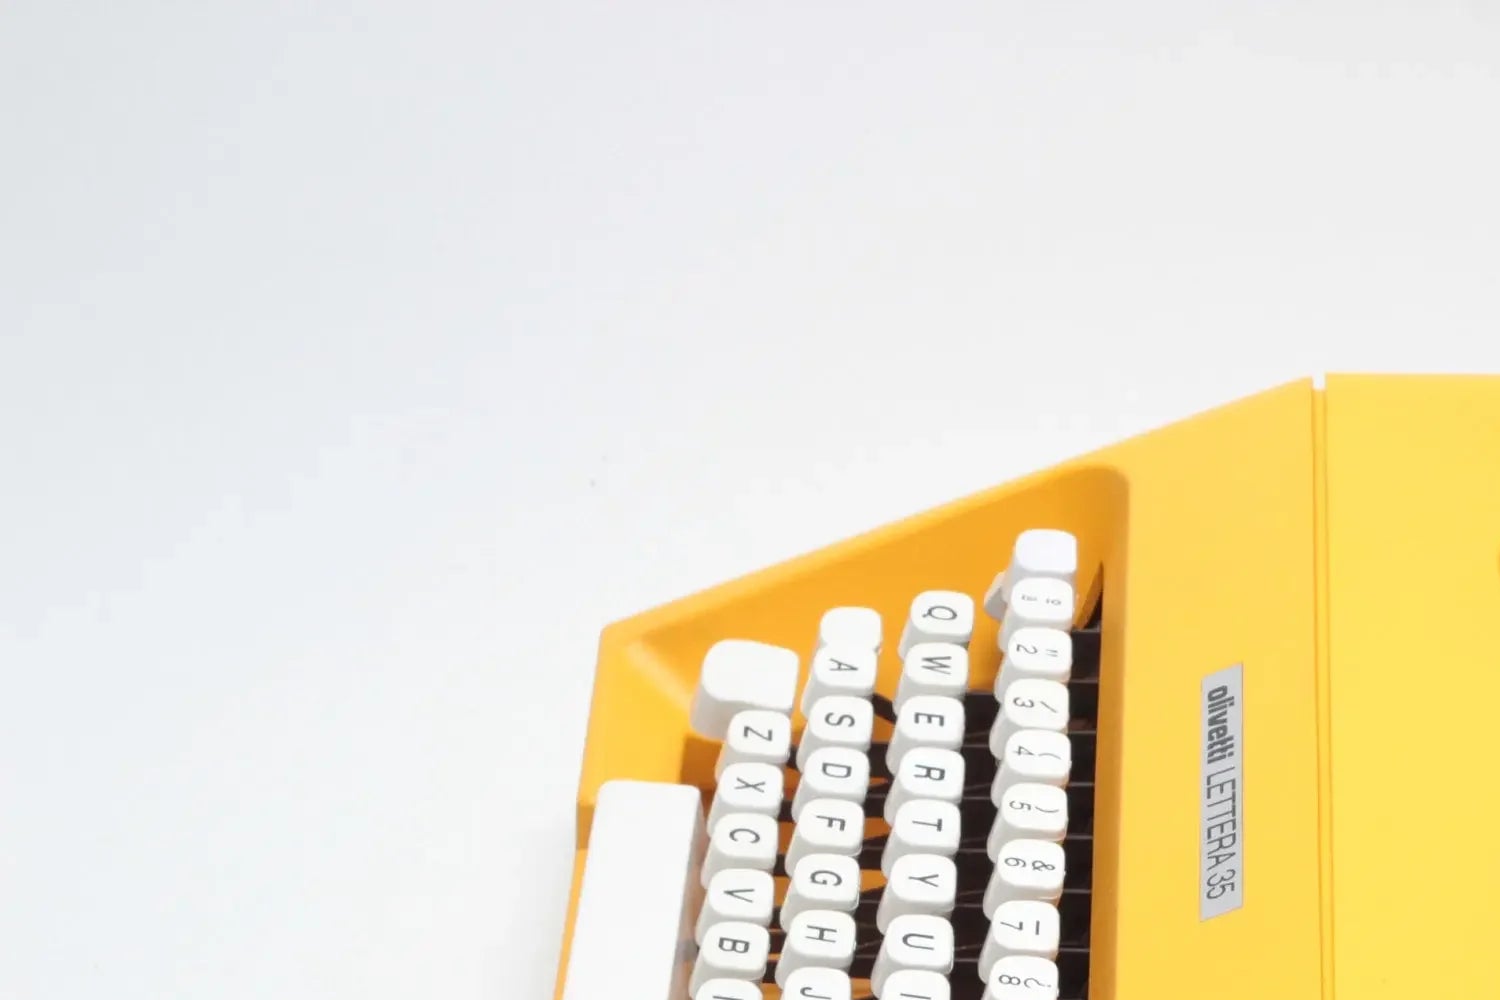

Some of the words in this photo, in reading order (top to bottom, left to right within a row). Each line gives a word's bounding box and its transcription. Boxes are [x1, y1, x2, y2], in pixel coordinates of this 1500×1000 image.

[923, 606, 957, 620] Q
[1015, 643, 1039, 655] 2
[830, 659, 858, 671] A
[922, 656, 951, 674] W
[1012, 696, 1035, 709] 3
[825, 713, 855, 727] S
[914, 712, 944, 726] E
[1207, 686, 1234, 764] olivetti
[744, 726, 772, 741] Z
[1014, 745, 1035, 756] 4
[822, 763, 852, 778] D
[914, 765, 945, 781] R
[736, 778, 765, 792] X
[1008, 800, 1032, 811] 5
[817, 816, 845, 831] F
[1207, 767, 1236, 869] LETTERA
[913, 819, 942, 832] T
[729, 829, 760, 843] C
[1004, 857, 1027, 868] 6
[1031, 859, 1056, 872] &
[810, 870, 842, 886] G
[909, 874, 939, 887] Y
[1207, 869, 1235, 899] 35
[724, 889, 754, 902] V
[1000, 921, 1024, 931] 7
[806, 925, 837, 942] H
[719, 937, 750, 953] B
[902, 933, 934, 950] U
[998, 974, 1022, 986] 8
[800, 987, 831, 1000] J
